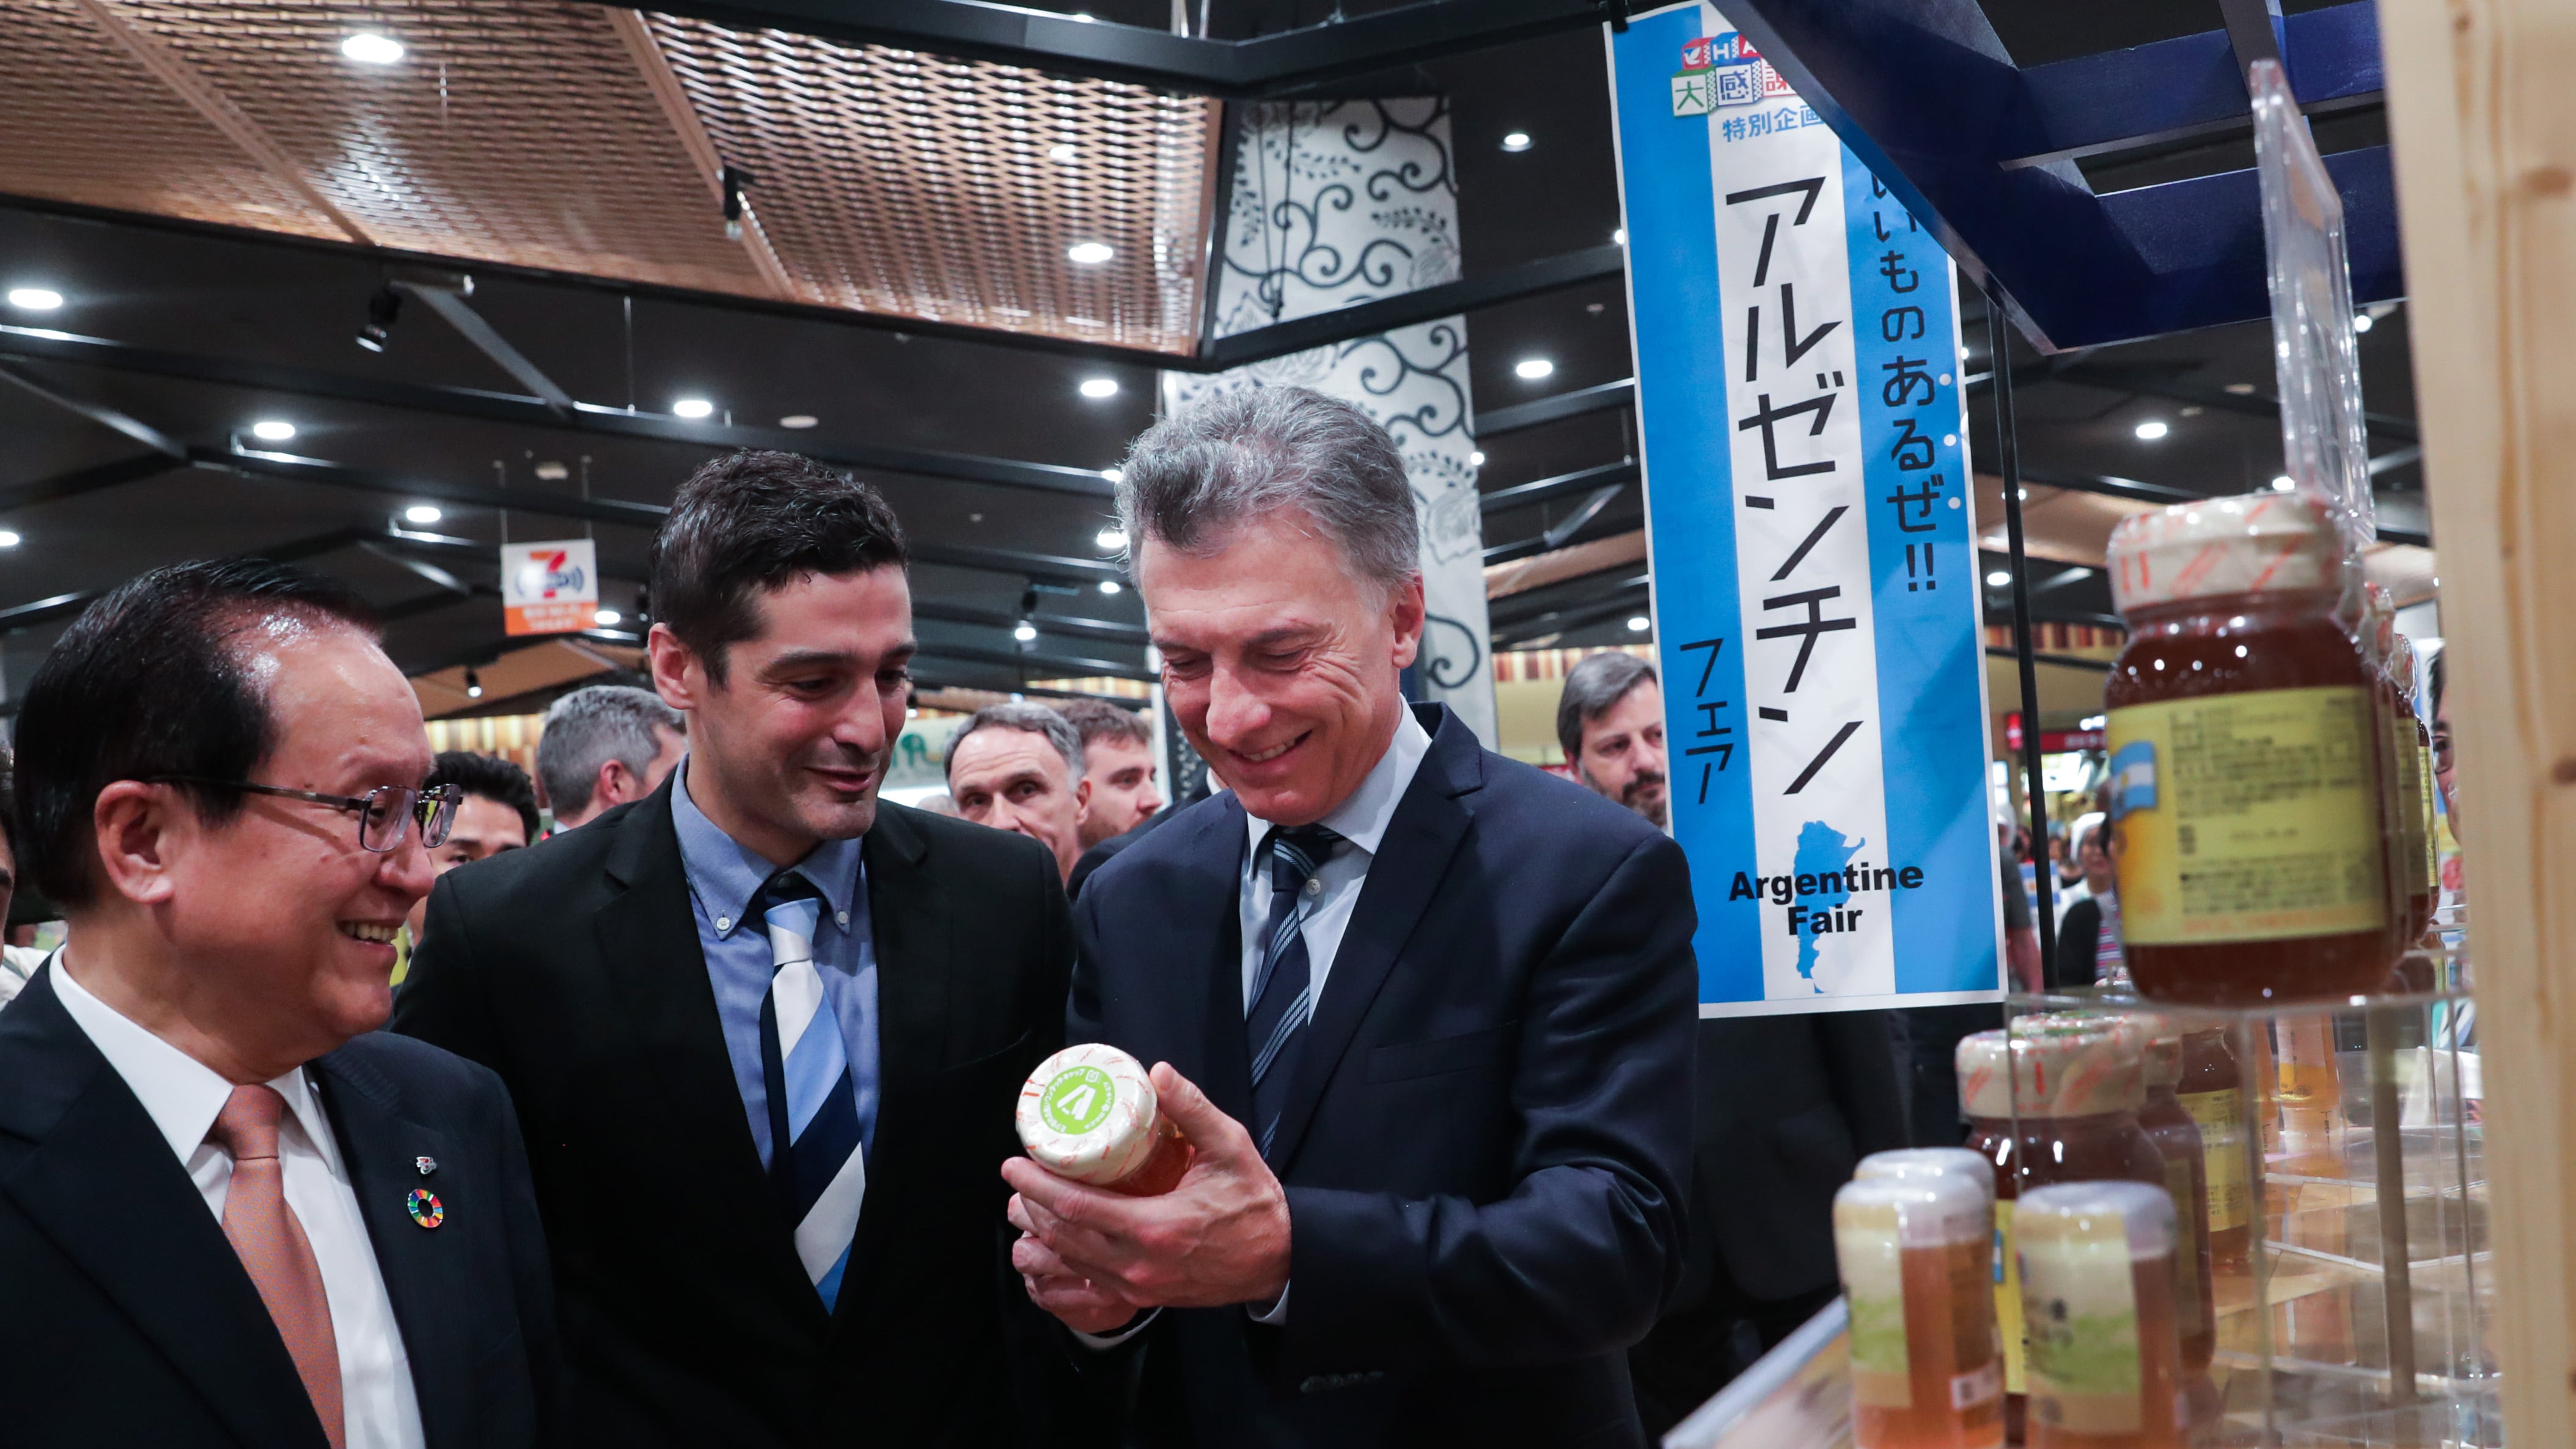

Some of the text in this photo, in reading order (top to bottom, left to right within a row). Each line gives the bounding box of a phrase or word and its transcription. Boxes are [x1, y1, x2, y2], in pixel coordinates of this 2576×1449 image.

[1726, 176, 1865, 795] アルゼンチン
[1679, 638, 1734, 804] フェア
[1728, 862, 1924, 905] Argentine
[1787, 905, 1863, 936] Fair
